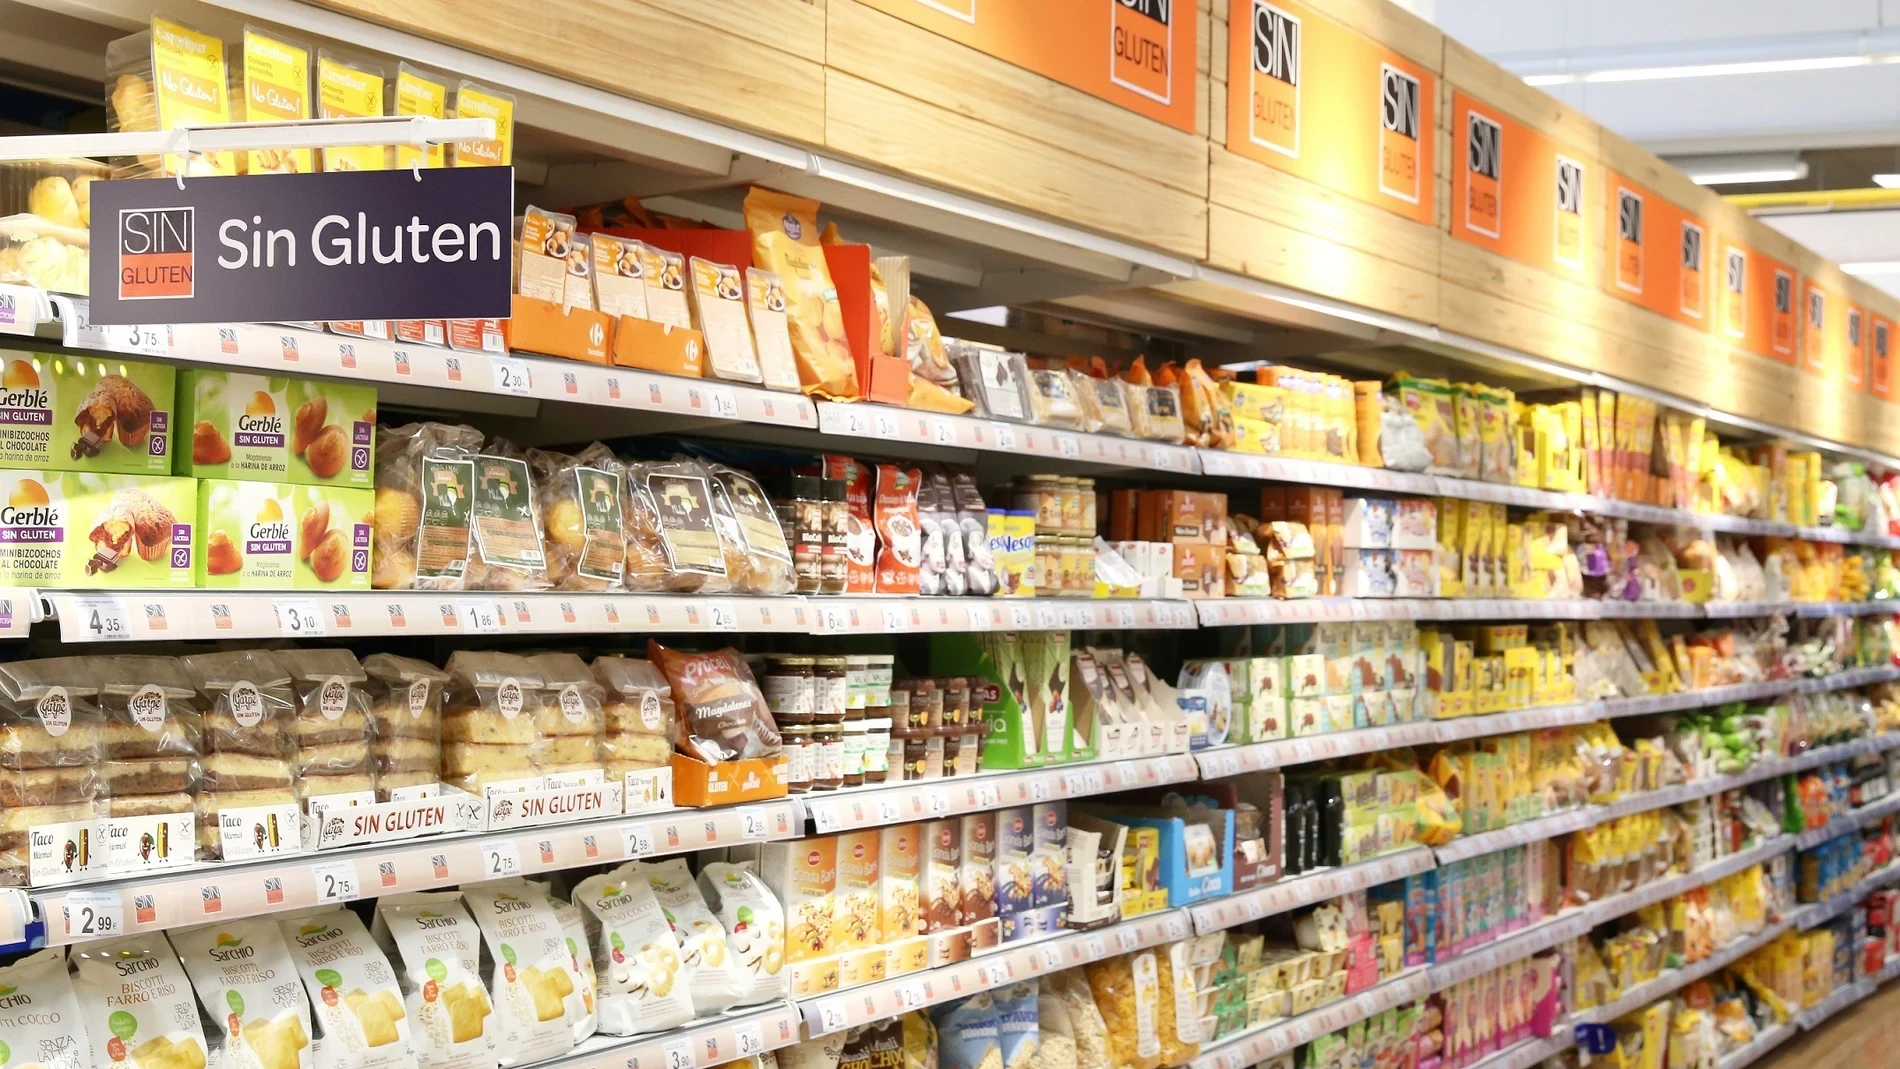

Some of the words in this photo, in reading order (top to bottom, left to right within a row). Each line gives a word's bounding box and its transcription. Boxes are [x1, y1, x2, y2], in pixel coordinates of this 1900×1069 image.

[1114, 26, 1169, 76] GLUTEN
[1255, 5, 1297, 85] SIN
[162, 71, 177, 92] No
[322, 66, 366, 92] Carrefour
[251, 83, 265, 103] No
[460, 95, 500, 117] Carrefour
[1253, 90, 1297, 131] GLUTEN
[1383, 69, 1418, 140] SIN
[458, 141, 471, 155] No
[1469, 115, 1499, 180] SIN
[1382, 145, 1416, 180] GLUTEN
[1558, 159, 1582, 213] SIN
[1620, 191, 1642, 243] SIN
[122, 212, 189, 255] SIN
[217, 216, 296, 270] Sin
[311, 212, 501, 267] Gluten
[121, 266, 192, 287] GLUTEN
[129, 325, 140, 346] 3
[144, 332, 157, 346] 75
[219, 328, 237, 342] SIN
[501, 367, 511, 387] 2
[513, 376, 522, 387] 30
[0, 387, 48, 409] Gerblé
[12, 412, 45, 422] GLUTEN
[239, 414, 282, 433] Gerblé
[6, 440, 47, 452] CHOCOLATE
[239, 435, 251, 444] SIN
[252, 436, 279, 445] GLUTEN
[240, 463, 260, 471] HARINA
[261, 464, 269, 472] DE
[269, 464, 286, 472] ARROZ
[1, 506, 59, 526] Gerblé
[2, 530, 17, 539] SIN
[21, 530, 56, 539] GLUTEN
[250, 522, 289, 540] Gerblé
[0, 549, 61, 559] MINIBIZCOCHOS
[250, 543, 262, 552] SIN
[262, 543, 287, 551] GLUTEN
[1, 560, 11, 569] AL
[13, 560, 59, 570] CHOCOLATE
[11, 570, 33, 579] harina
[34, 571, 43, 580] de
[251, 570, 269, 578] HARINA
[269, 570, 276, 578] DE
[144, 604, 165, 617] SIN
[211, 604, 231, 617] SIN
[331, 604, 350, 617] SIN
[470, 608, 479, 628] 1
[713, 608, 722, 625] 2
[90, 609, 103, 635] 4
[106, 618, 120, 631] 35
[288, 608, 301, 631] 3
[303, 616, 315, 628] 10
[696, 699, 752, 719] Magdalenas
[545, 777, 563, 790] Taco
[628, 776, 640, 787] Taco
[521, 796, 546, 819] SIN
[549, 791, 602, 814] GLUTEN
[882, 803, 888, 818] 2
[220, 813, 242, 828] Taco
[354, 813, 381, 837] SIN
[385, 806, 445, 832] GLUTEN
[747, 816, 754, 833] 2
[31, 831, 54, 847] Taco
[629, 834, 637, 854] 2
[640, 840, 647, 850] 59
[225, 846, 234, 856] Sin
[235, 846, 254, 855] Gluten
[379, 862, 396, 875] SIN
[432, 855, 447, 867] SIN
[491, 852, 501, 873] 2
[503, 857, 512, 869] 75
[32, 868, 42, 878] Sin
[42, 867, 60, 876] Gluten
[264, 877, 282, 891] SIN
[325, 874, 336, 898] 2
[338, 881, 350, 893] 75
[201, 886, 220, 900] SIN
[135, 895, 154, 910] SIN
[626, 900, 656, 917] COCCO
[81, 907, 94, 934] 2
[98, 916, 112, 930] 99
[499, 914, 537, 929] BISCOTTI
[425, 930, 461, 944] BISCOTTI
[495, 926, 520, 939] FARRO
[529, 922, 547, 934] RISO
[308, 939, 352, 959] BISCOTTI
[347, 947, 364, 957] RISO
[420, 941, 449, 955] FARRO
[219, 974, 246, 986] FARRO
[251, 969, 275, 984] RISO
[221, 963, 258, 976] BISCOTTI
[121, 974, 164, 994] BISCOTTI
[273, 981, 299, 996] SENZA
[0, 994, 32, 1009] CHIO
[107, 991, 149, 1007] FARRO
[150, 990, 156, 999] E
[156, 983, 176, 997] RISO
[174, 1002, 192, 1013] SENZA
[18, 1012, 61, 1027] COCCO
[180, 1020, 196, 1031] UOVA
[828, 1010, 834, 1026] 2
[39, 1035, 77, 1050] SENZA
[742, 1035, 749, 1053] 3
[672, 1051, 680, 1069] 3
[681, 1057, 690, 1067] 90
